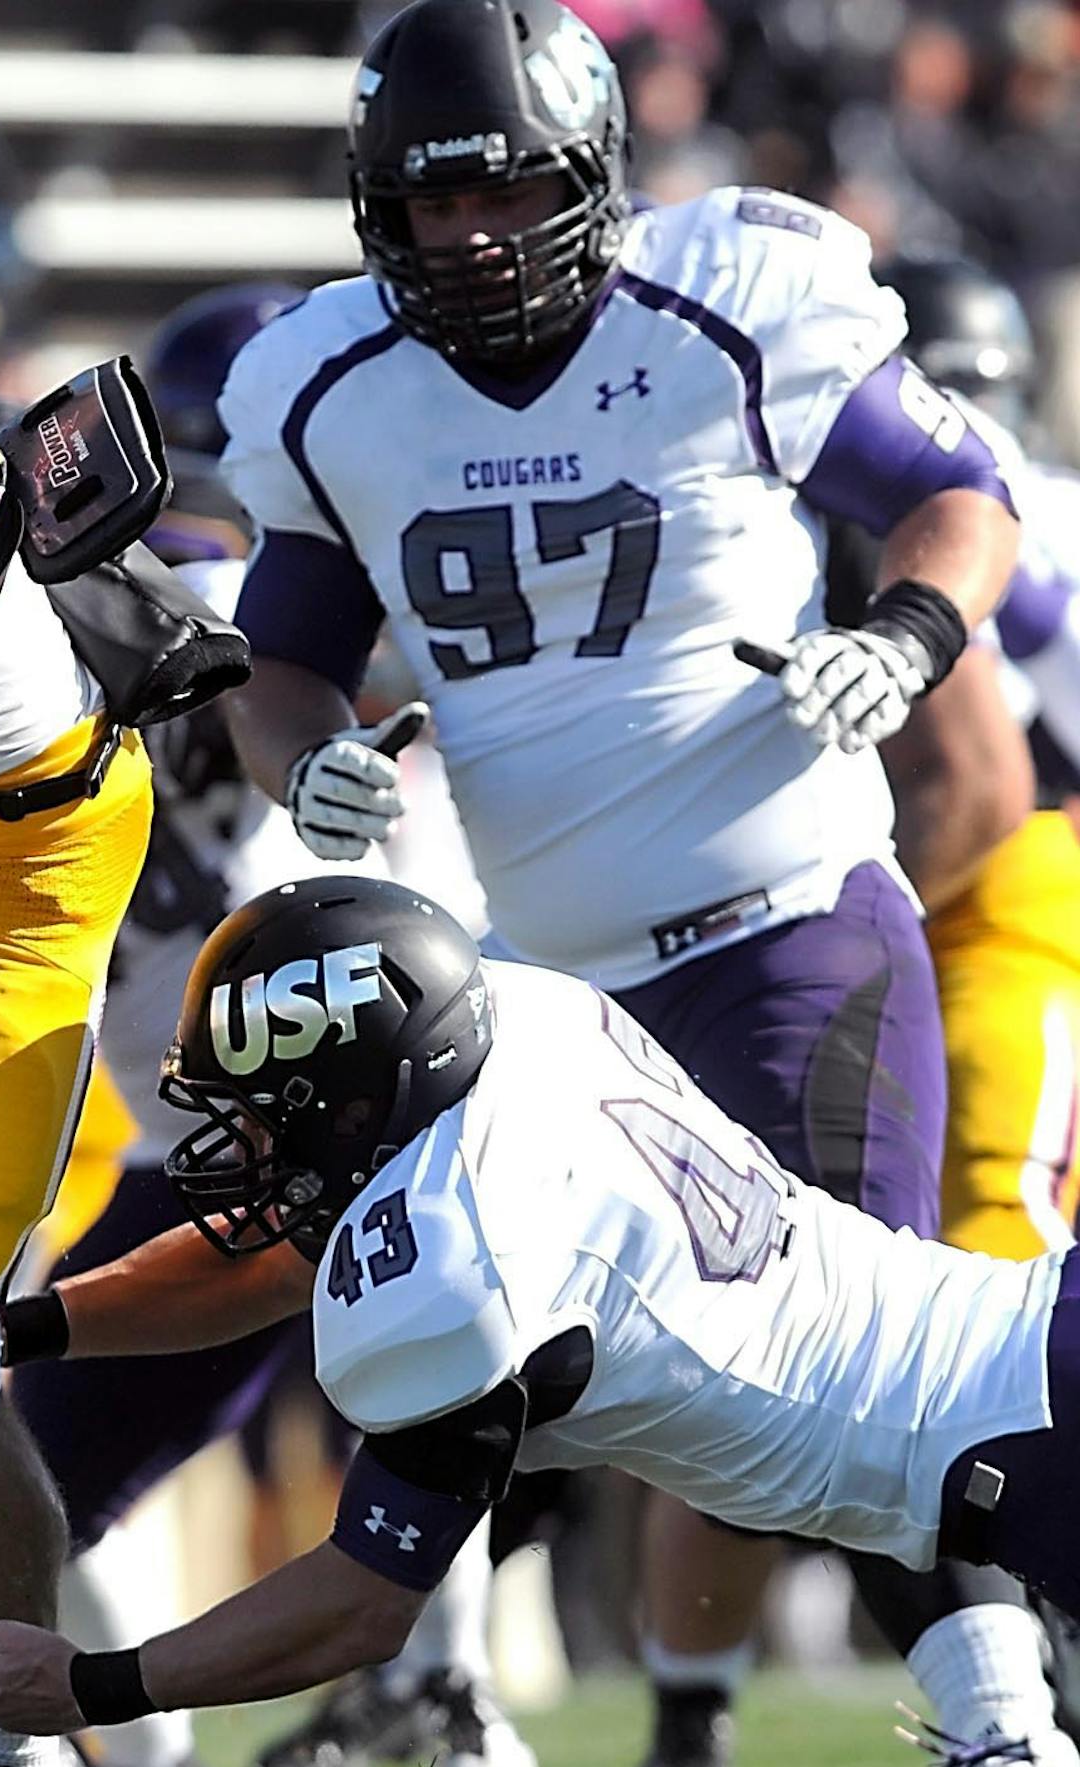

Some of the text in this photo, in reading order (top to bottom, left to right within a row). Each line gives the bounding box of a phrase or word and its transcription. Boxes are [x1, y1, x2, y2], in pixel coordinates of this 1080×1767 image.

[38, 415, 82, 488] POWER
[463, 452, 582, 491] COUGARS
[401, 477, 661, 681] 97
[210, 940, 384, 1076] USF
[327, 1187, 419, 1308] 43
